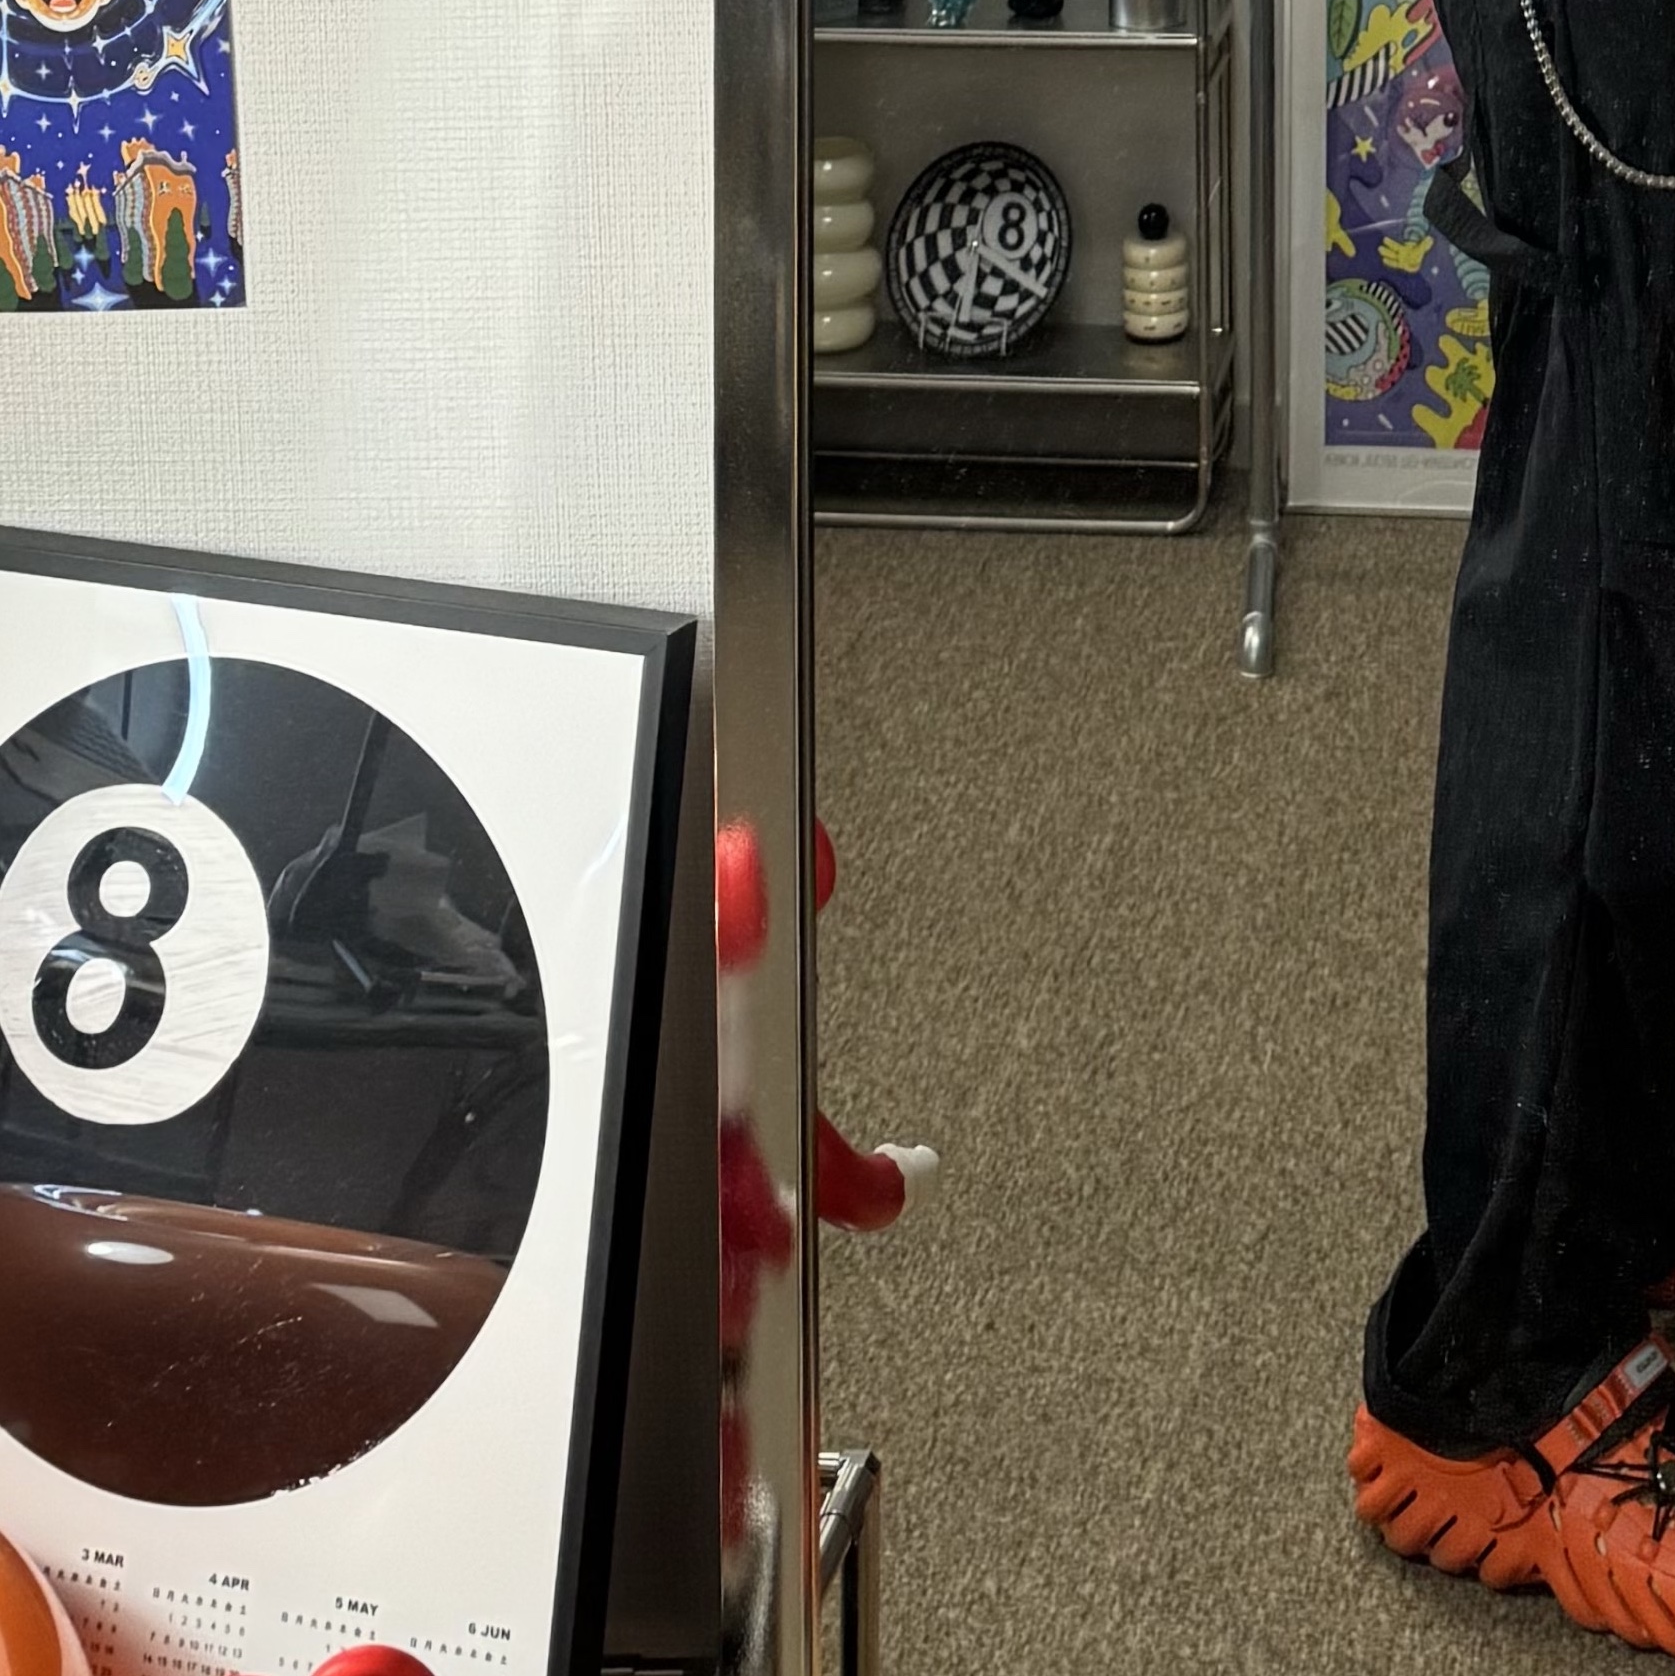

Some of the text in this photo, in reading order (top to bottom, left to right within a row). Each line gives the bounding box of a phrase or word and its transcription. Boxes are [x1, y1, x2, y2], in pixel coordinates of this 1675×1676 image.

[32, 827, 189, 1070] 8
[82, 1548, 124, 1568] 3 MAR
[208, 1573, 249, 1591] 4 APR
[335, 1597, 378, 1616] 5 MAY
[481, 1624, 510, 1641] JUN
[204, 1643, 214, 1653] 11
